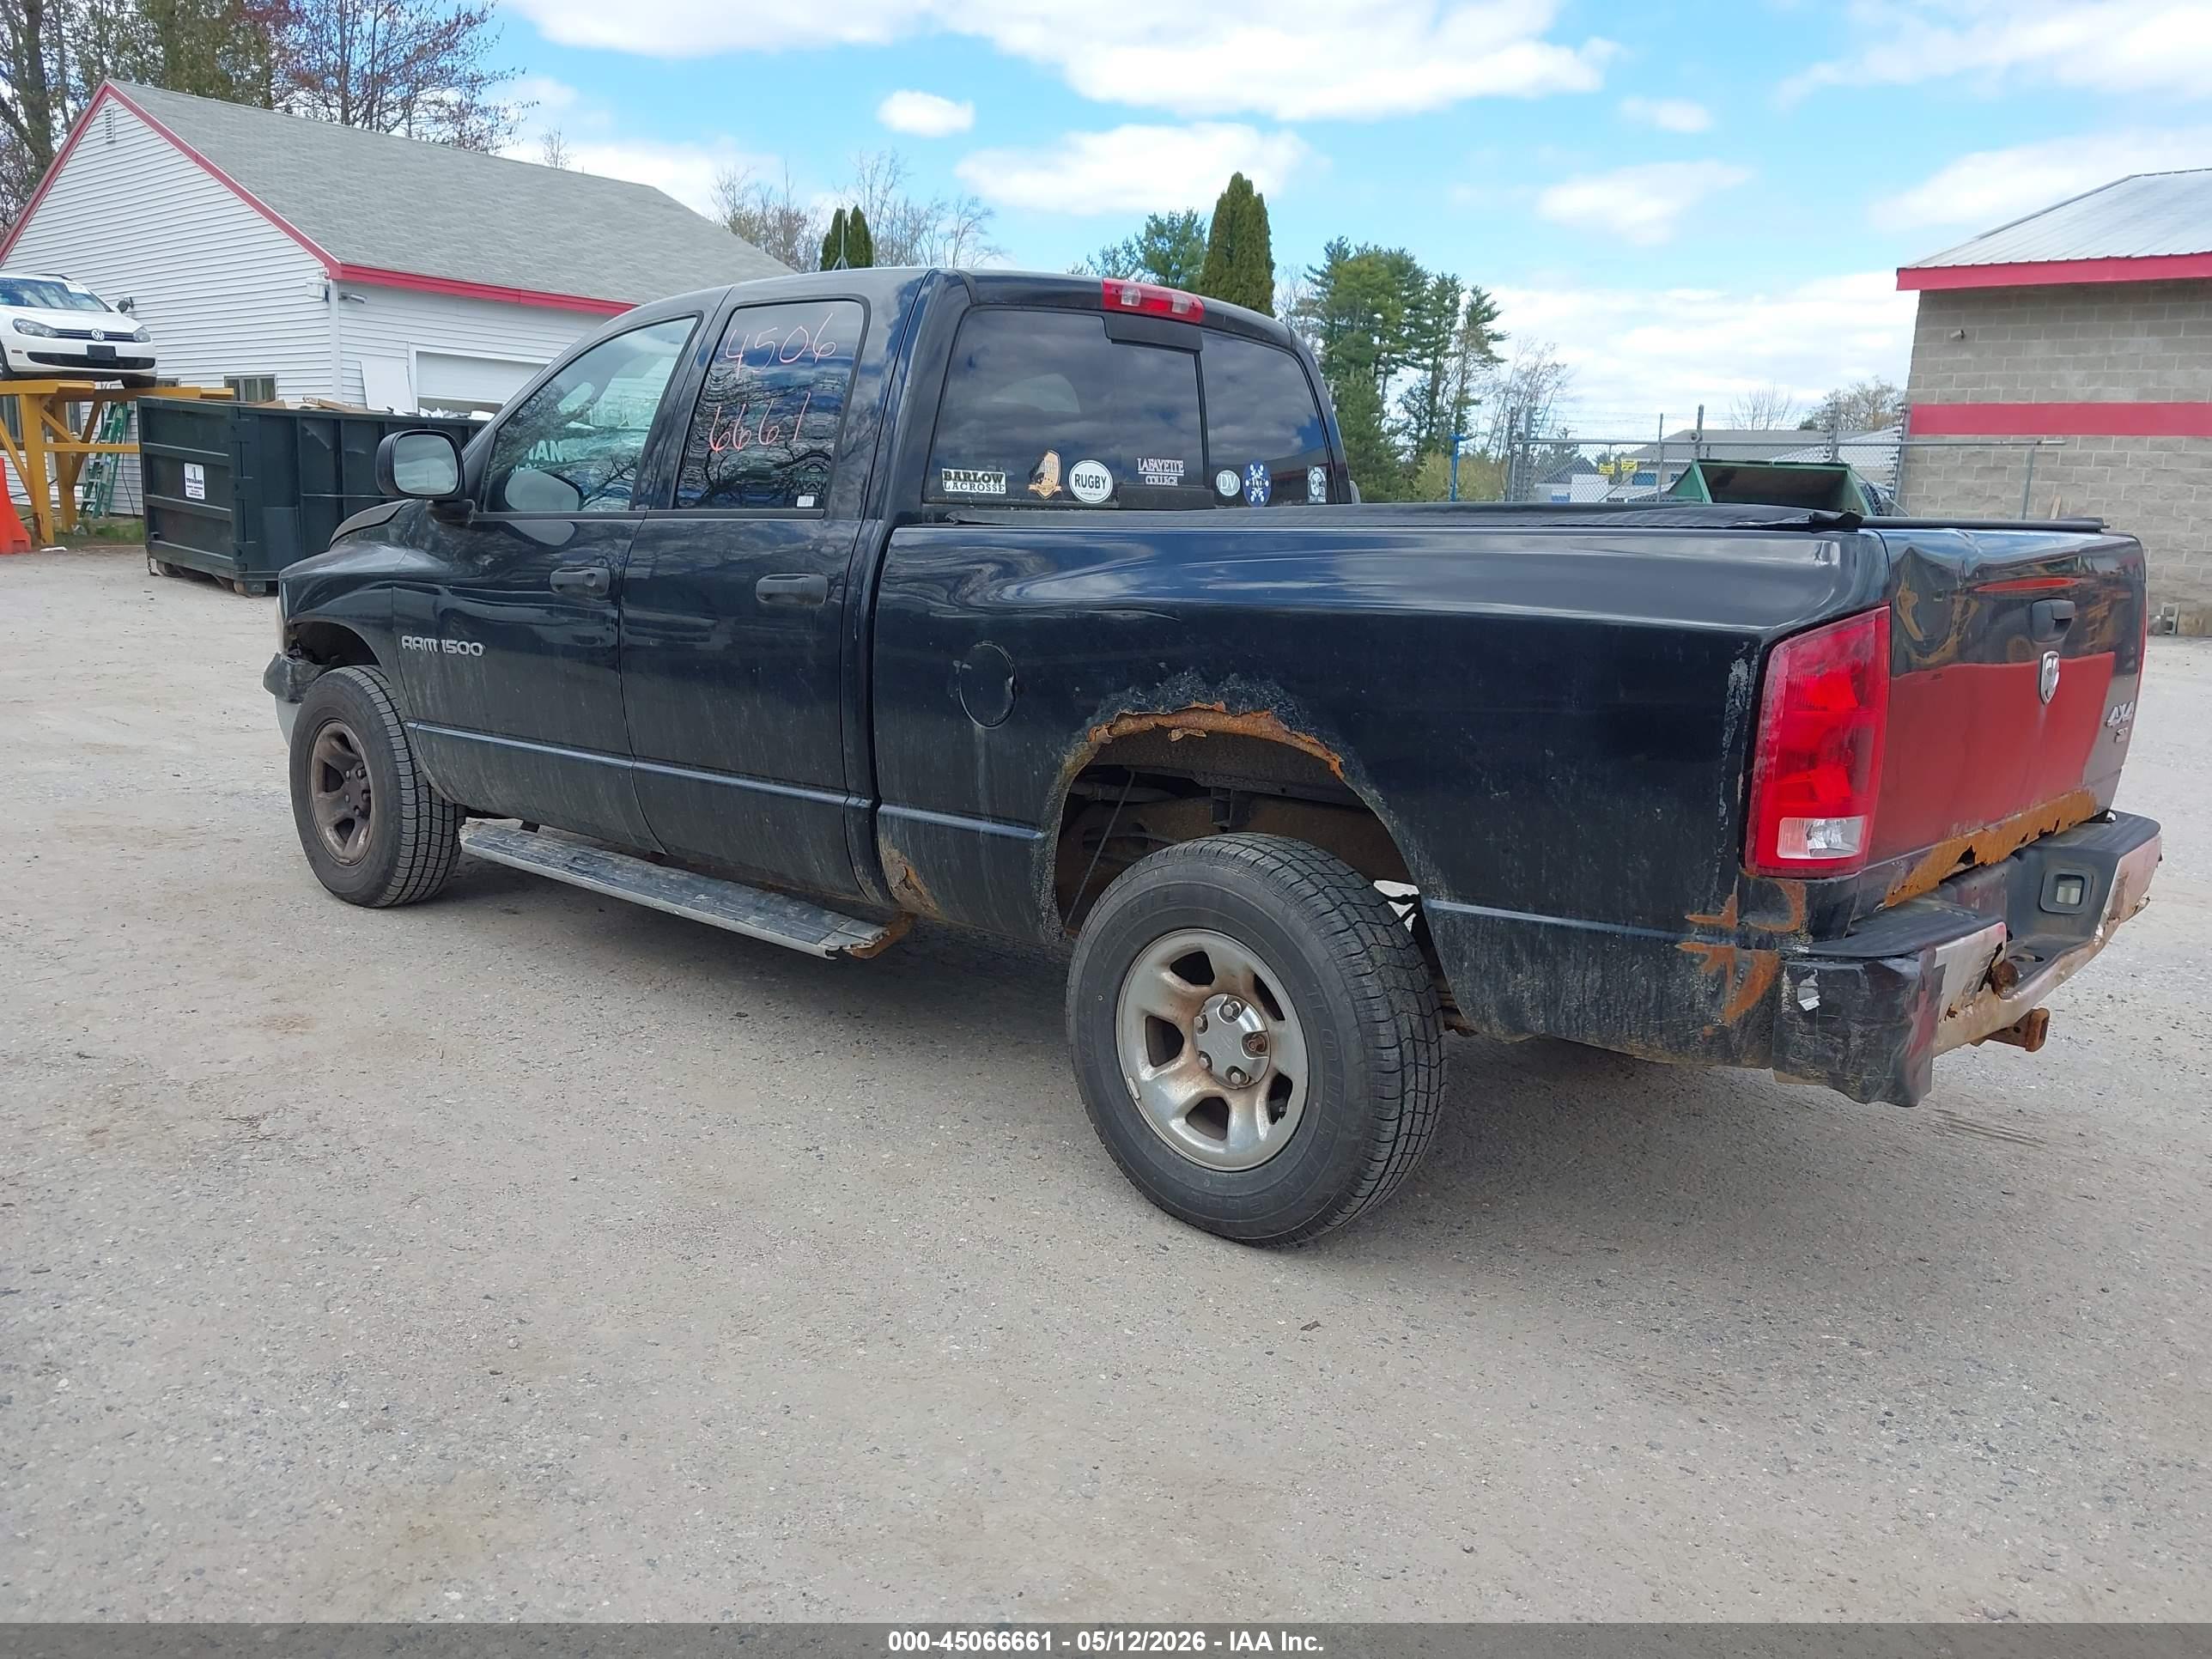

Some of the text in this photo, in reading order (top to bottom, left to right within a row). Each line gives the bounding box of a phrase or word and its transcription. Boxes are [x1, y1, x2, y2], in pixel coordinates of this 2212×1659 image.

[726, 313, 836, 379] 4506
[709, 392, 811, 453] 6661
[1137, 458, 1184, 473] LAFAYETTE
[943, 471, 1005, 483] BARLOW
[1074, 473, 1107, 489] RUGBY
[1219, 474, 1237, 489] DV
[944, 482, 1005, 492] LACROSSE
[401, 635, 483, 656] RAM 1500
